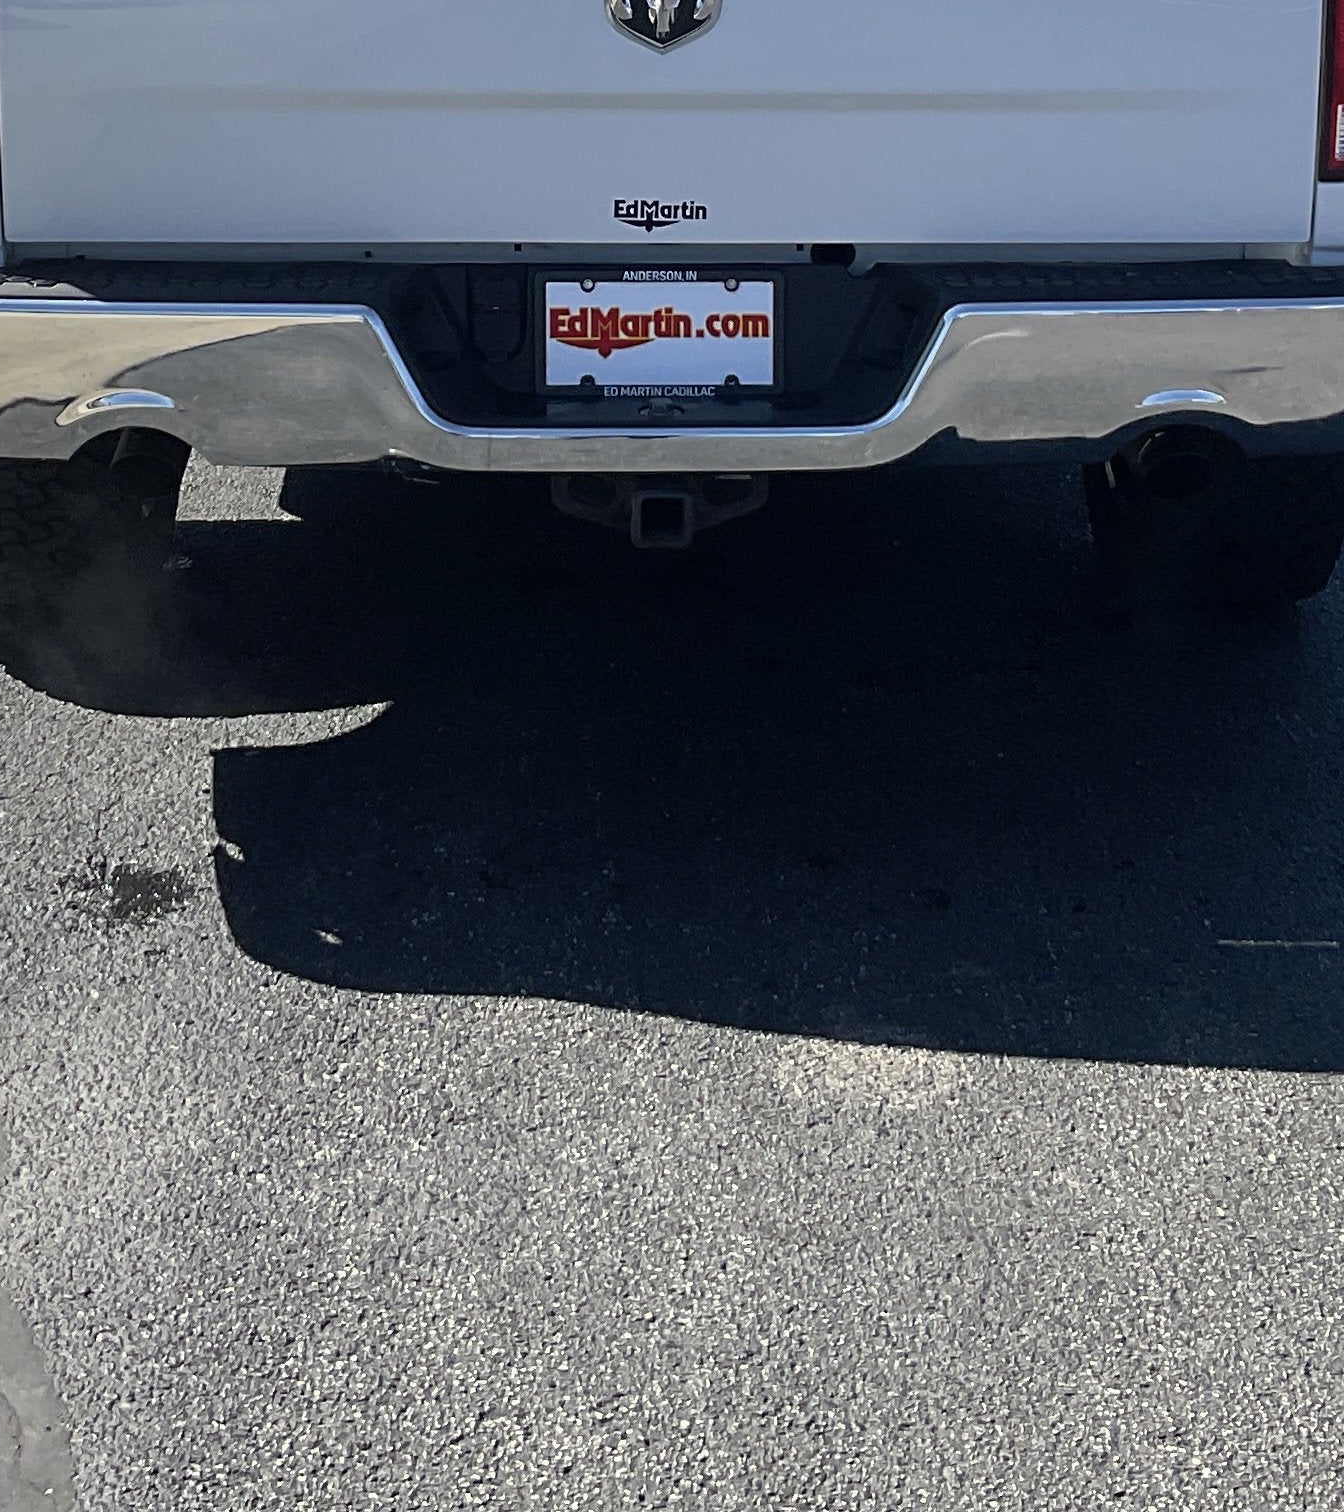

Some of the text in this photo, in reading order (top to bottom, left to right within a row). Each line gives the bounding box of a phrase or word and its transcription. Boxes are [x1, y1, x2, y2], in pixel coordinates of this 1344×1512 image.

[622, 270, 698, 282] ANDERSON, IN
[549, 306, 769, 338] EdMartin.com
[603, 386, 716, 397] ED MARTIN CADILLAC
